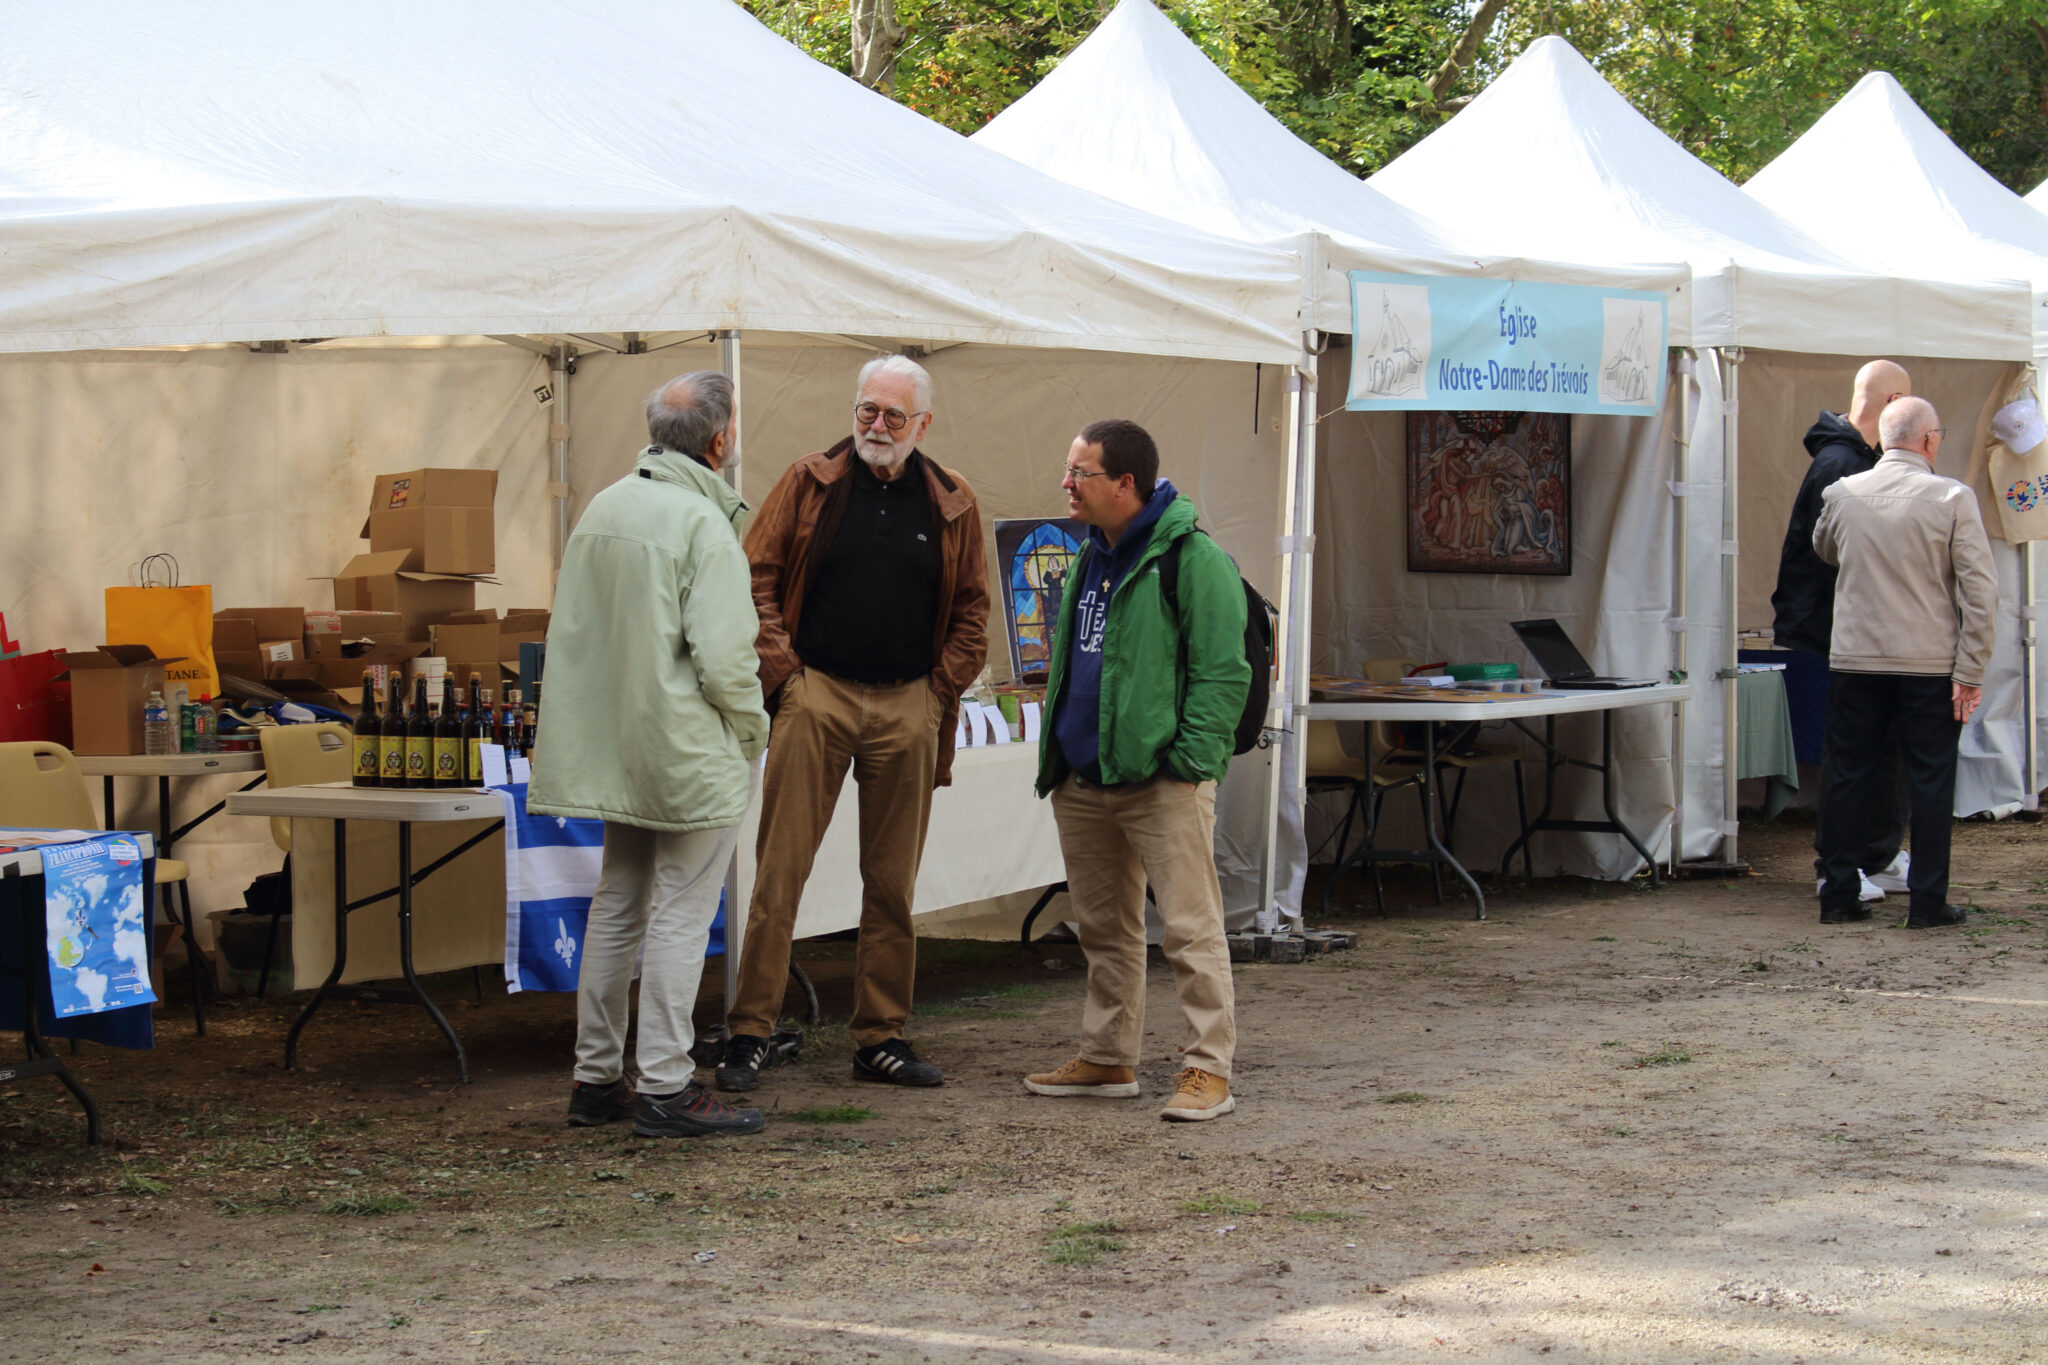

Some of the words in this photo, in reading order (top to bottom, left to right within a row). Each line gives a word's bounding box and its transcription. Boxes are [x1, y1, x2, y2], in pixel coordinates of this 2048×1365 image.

[1499, 298, 1537, 346] Église
[1439, 358, 1526, 392] Notre-Dame
[1527, 360, 1549, 393] des
[1550, 362, 1589, 395] Trévois
